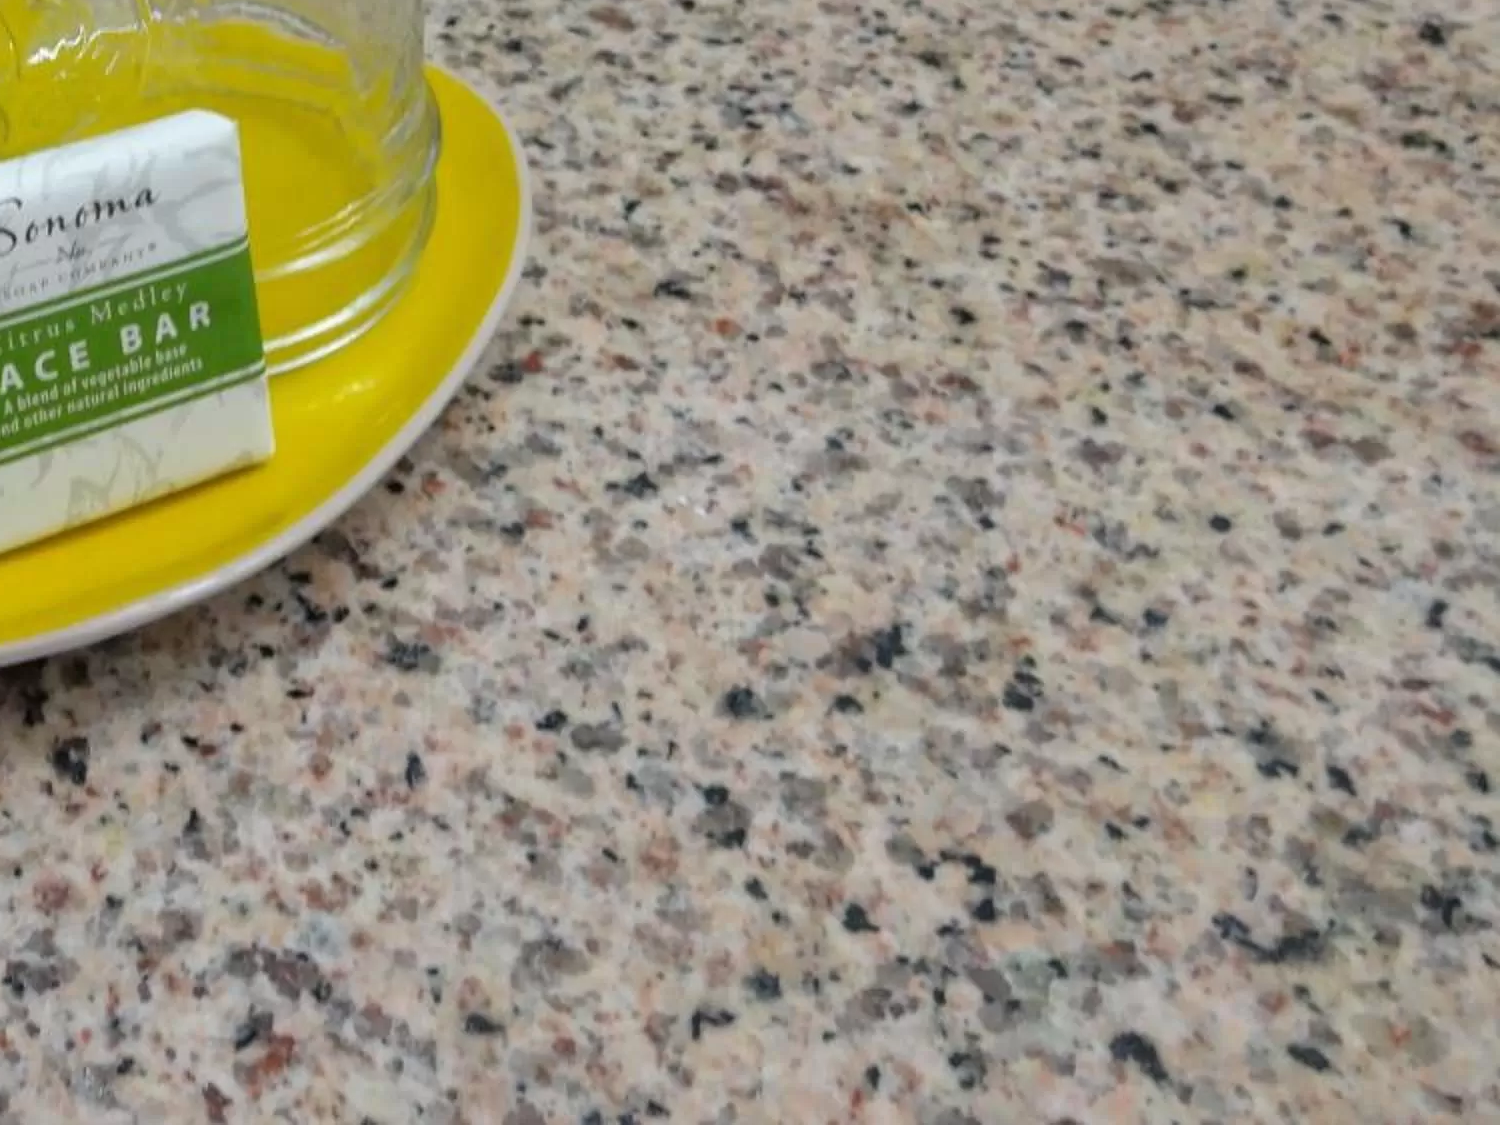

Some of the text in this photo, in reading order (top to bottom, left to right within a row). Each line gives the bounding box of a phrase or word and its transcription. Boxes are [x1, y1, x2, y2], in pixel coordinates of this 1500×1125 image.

[90, 281, 188, 326] Medley
[119, 300, 212, 356] BAR
[3, 342, 188, 417] A blend of vegetable base
[23, 404, 63, 429] other
[67, 384, 121, 415] natural
[122, 358, 205, 396] ingredients
